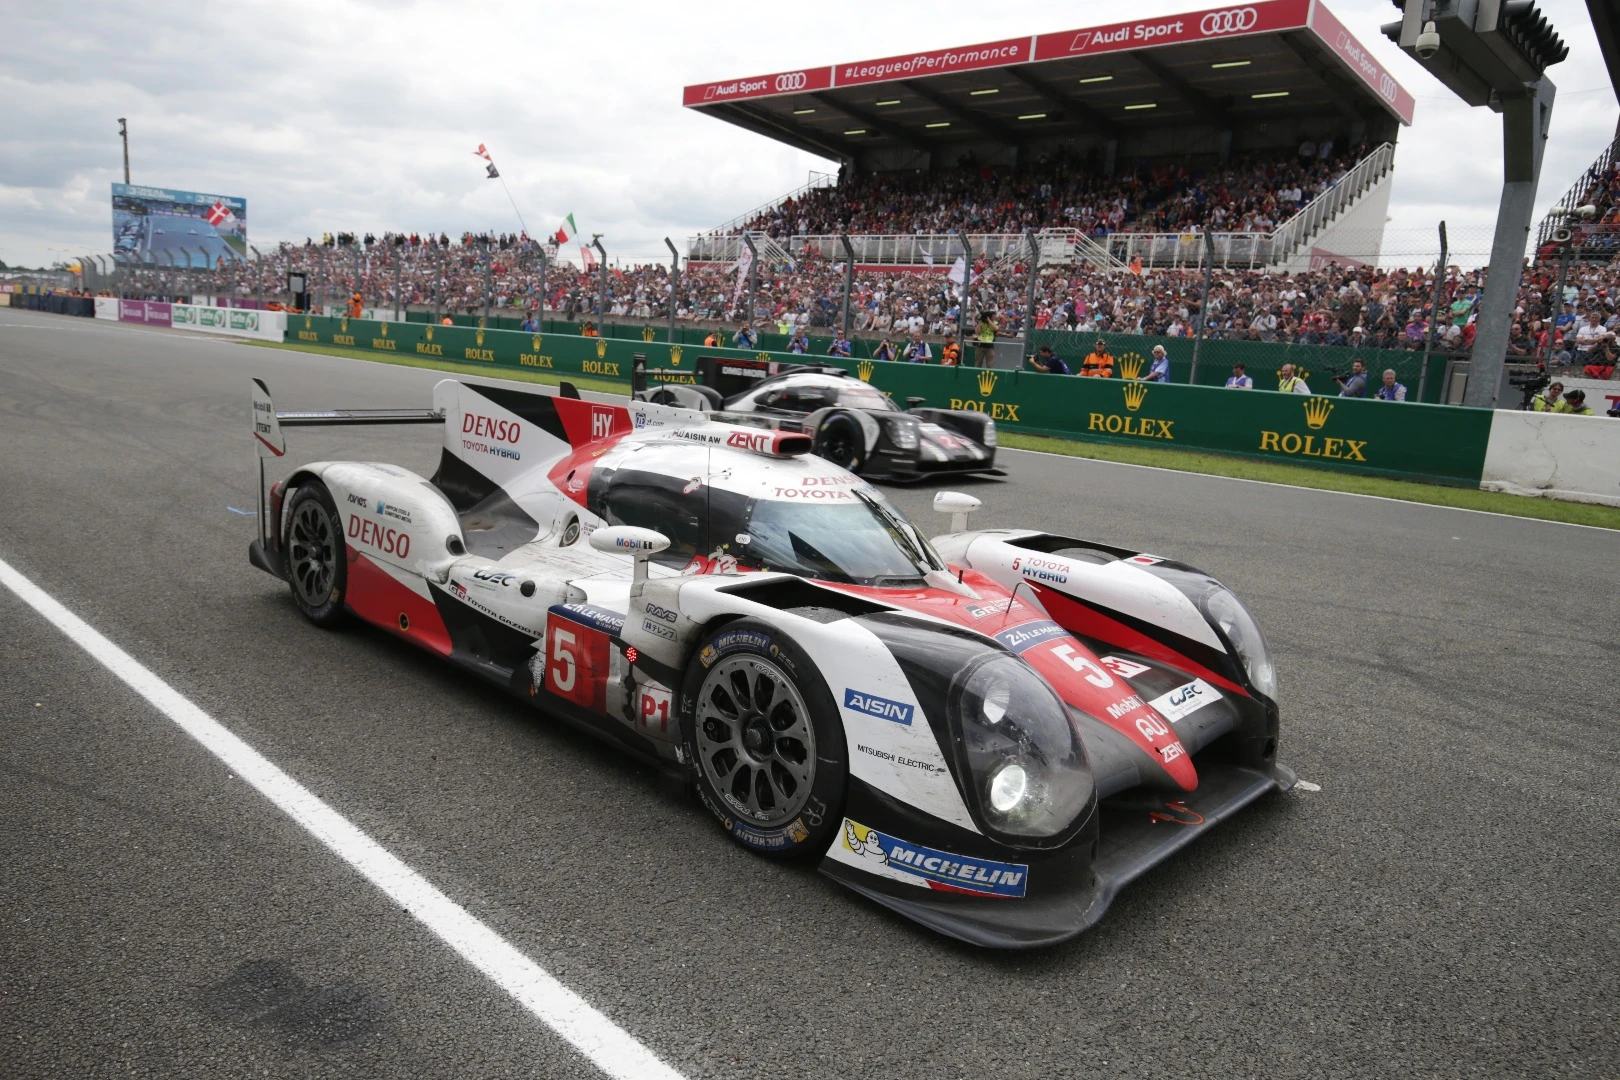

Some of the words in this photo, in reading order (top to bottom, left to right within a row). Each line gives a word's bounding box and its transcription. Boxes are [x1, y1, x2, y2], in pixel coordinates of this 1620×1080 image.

[1091, 27, 1130, 45] Audi
[1134, 20, 1184, 41] Sport
[845, 45, 1019, 79] #LeagueofPerformance
[1345, 38, 1361, 61] Audi
[1360, 53, 1377, 80] Sport
[716, 82, 737, 96] Audi
[739, 79, 767, 95] Sport
[333, 334, 355, 346] ROLEX
[372, 338, 396, 350] ROLEX
[416, 343, 443, 356] ROLEX
[465, 348, 495, 361] ROLEX
[520, 353, 553, 368] ROLEX
[582, 360, 620, 376] ROLEX
[462, 413, 521, 444] DENSO
[593, 413, 612, 438] HY
[1088, 412, 1174, 440] ROLEX
[685, 432, 707, 442] AISIN
[727, 431, 770, 452] ZENT
[1259, 430, 1367, 462] ROLEX
[462, 440, 489, 454] TOYOTA
[489, 446, 521, 461] HYBRID
[775, 487, 852, 499] TOYOTA
[348, 513, 410, 558] DENSO
[616, 537, 641, 548] Mobil
[1012, 557, 1022, 571] 5
[1027, 557, 1070, 573] TOYOTA
[473, 570, 517, 586] WEC
[1022, 566, 1067, 584] HYBRID
[467, 595, 497, 618] TOYOTA
[498, 615, 531, 633] GAZOO
[581, 608, 594, 617] LE
[593, 612, 624, 627] MANS
[646, 602, 678, 623] RAYS
[718, 633, 767, 649] MICHELIN
[1028, 629, 1042, 638] LE
[552, 627, 576, 692] 5
[1050, 643, 1114, 689] 5
[1169, 684, 1203, 706] WEC
[641, 694, 669, 733] P1
[849, 694, 909, 721] AISIN
[857, 744, 895, 763] MITSUBISHI
[898, 756, 935, 772] ELECTRIC
[735, 828, 785, 847] MICHELIN
[890, 846, 1023, 887] MICHELIN
